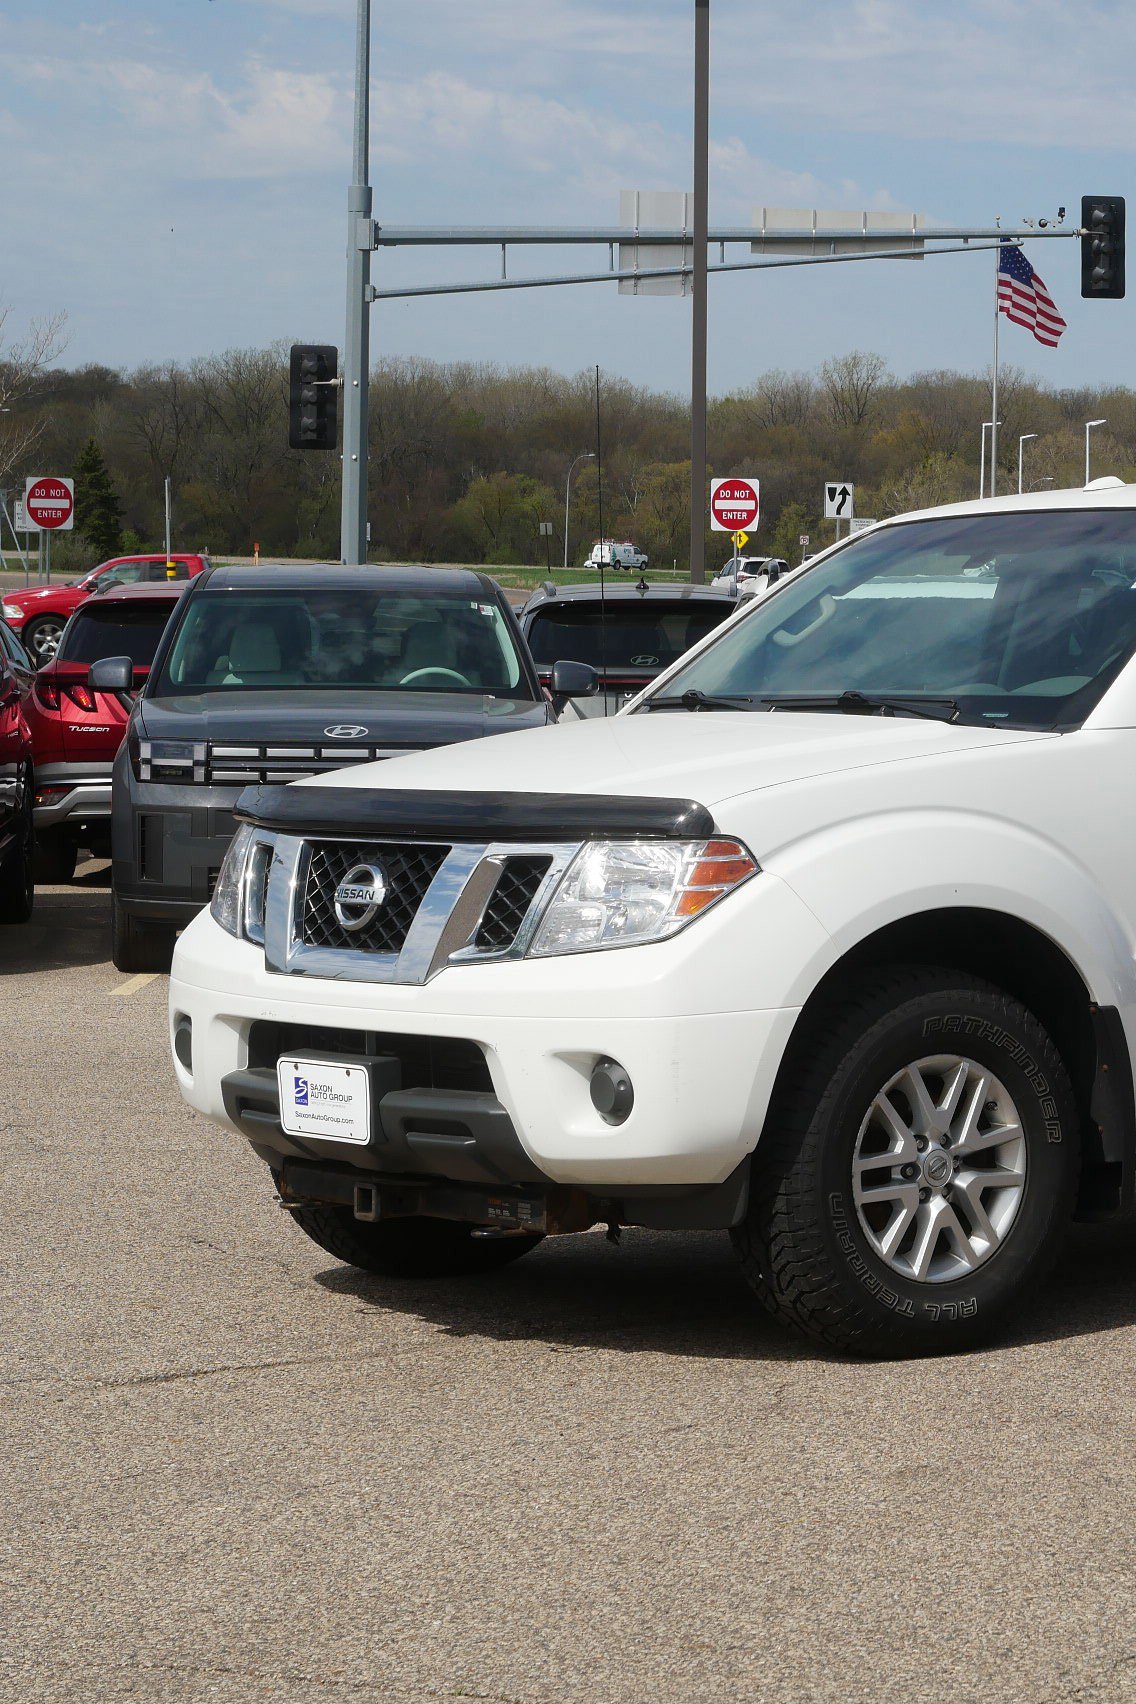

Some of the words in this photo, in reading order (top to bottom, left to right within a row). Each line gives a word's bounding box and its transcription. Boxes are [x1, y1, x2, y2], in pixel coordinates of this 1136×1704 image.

[34, 488, 46, 497] DO
[50, 488, 65, 497] NOT
[719, 489, 731, 499] DO
[734, 489, 750, 499] NOT
[37, 509, 62, 518] ENTER
[722, 511, 747, 520] ENTER
[922, 1014, 1062, 1143] PATHFINDER
[310, 1083, 333, 1093] SAXON
[310, 1091, 328, 1100] AUTO
[328, 1092, 353, 1103] GROUP
[295, 1110, 354, 1125] SaxonAutoGroup.com
[829, 1192, 915, 1318] TERRAIN
[925, 1297, 978, 1322] ALL
